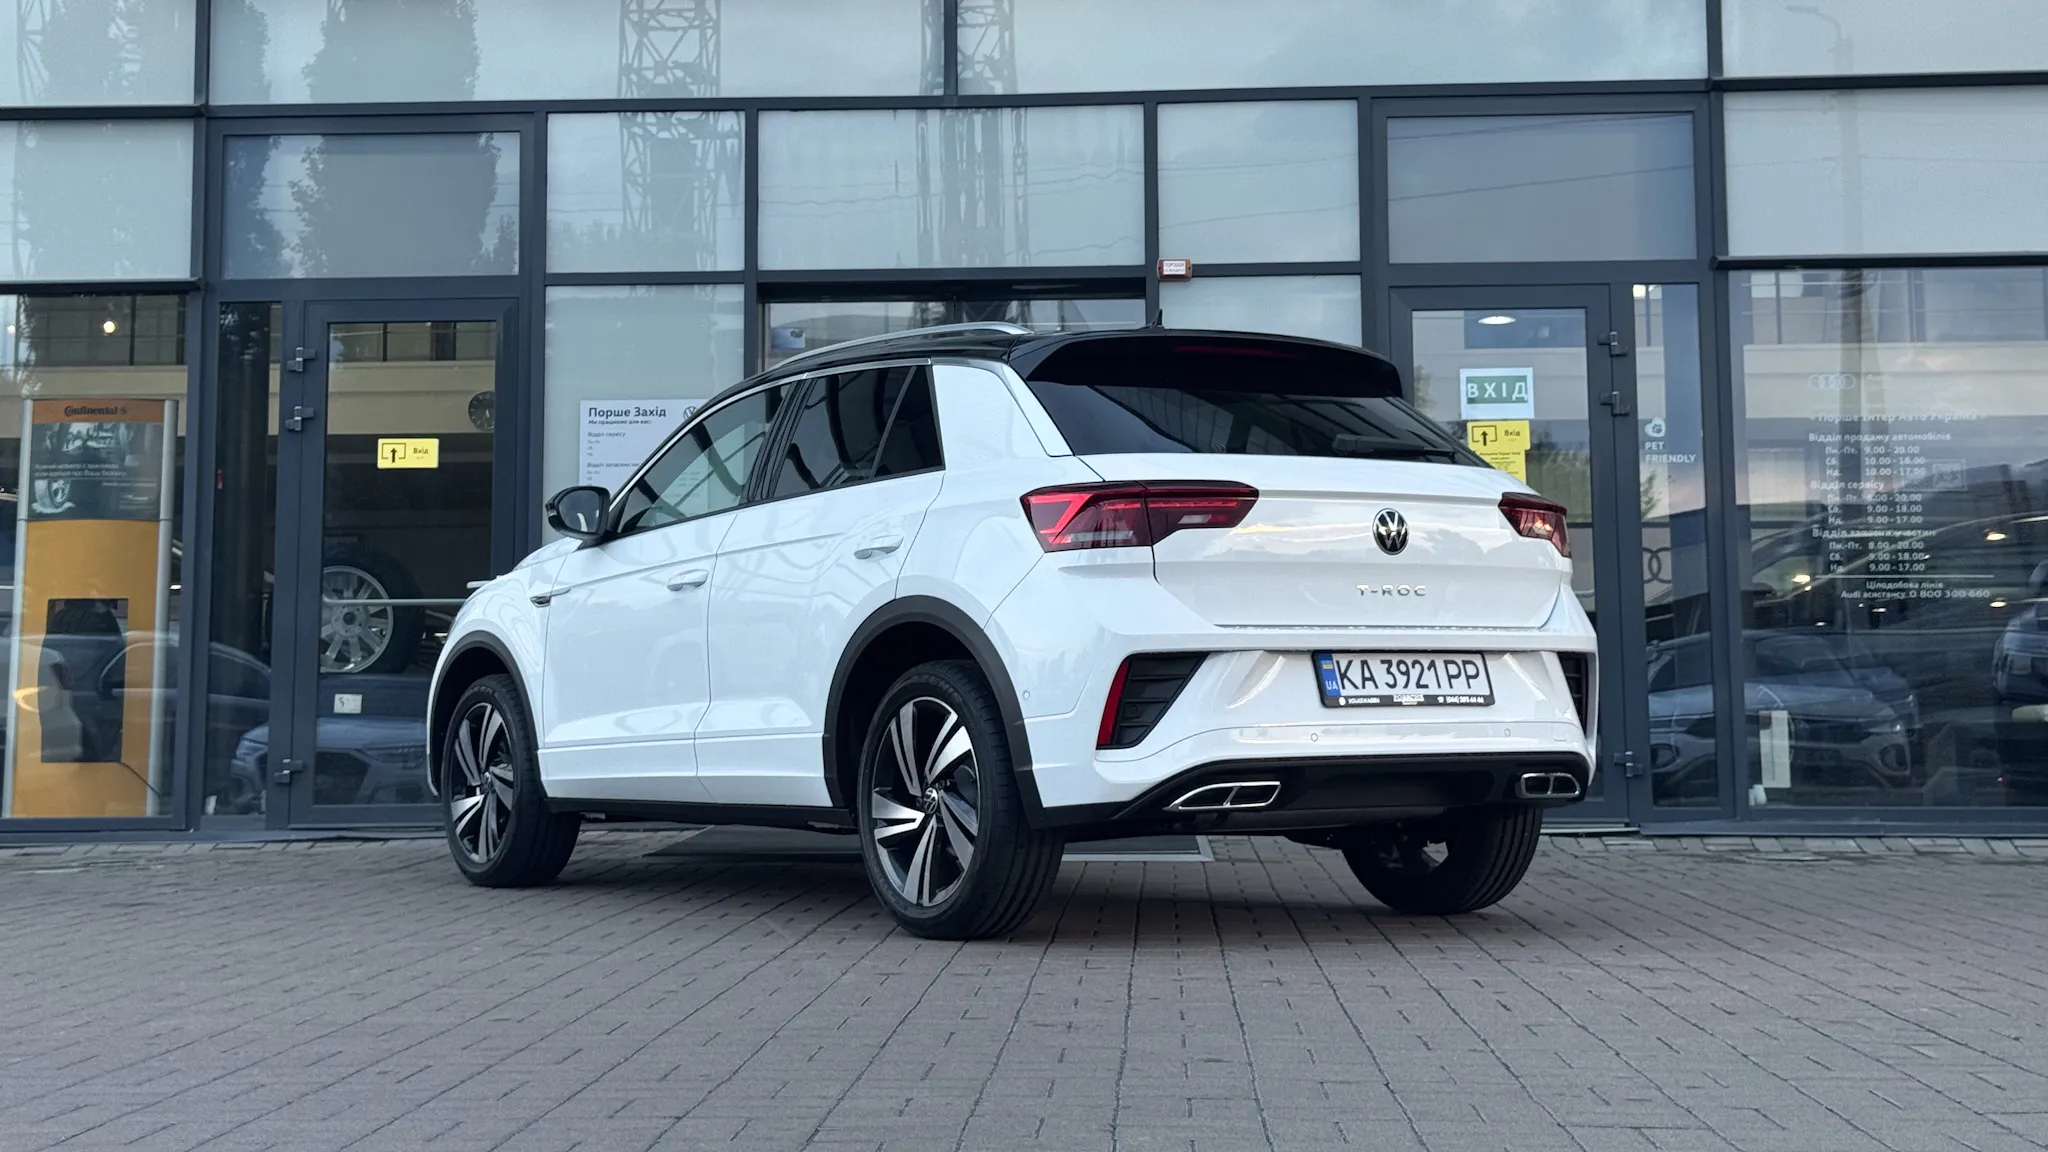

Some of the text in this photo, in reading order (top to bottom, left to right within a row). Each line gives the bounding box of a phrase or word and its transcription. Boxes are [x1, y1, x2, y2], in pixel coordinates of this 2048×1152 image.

[1467, 381, 1528, 400] ВХІД
[64, 405, 118, 417] Continental
[588, 406, 667, 419] Порше Захід
[1809, 432, 1952, 444] Відділ продажу автомобілів
[1644, 441, 1665, 451] PET
[1863, 446, 1885, 454] 9.00
[1893, 445, 1920, 454] 20.00
[1645, 453, 1697, 463] FRIENDLY
[1864, 457, 1891, 465] 10.00
[1899, 457, 1925, 465] 18.00
[1865, 468, 1891, 476] 10.00
[1810, 480, 1884, 491] Відділ сервісу
[1894, 494, 1922, 502] 20.00
[1866, 505, 1888, 513] 9.00
[1895, 505, 1922, 513] 18.00
[1867, 516, 1889, 524] 9.00
[1896, 516, 1923, 524] 17.00
[1897, 541, 1924, 549] 20.00
[1898, 552, 1925, 560] 18.00
[1869, 563, 1890, 572] 9.00
[1898, 563, 1925, 572] 17.00
[1866, 581, 1919, 590] Цілодобова
[1356, 584, 1427, 597] T-ROC
[1841, 590, 1860, 598] Audi
[1919, 590, 1942, 598] 800
[1336, 659, 1480, 690] KA 3921 PP
[1326, 680, 1338, 690] UA
